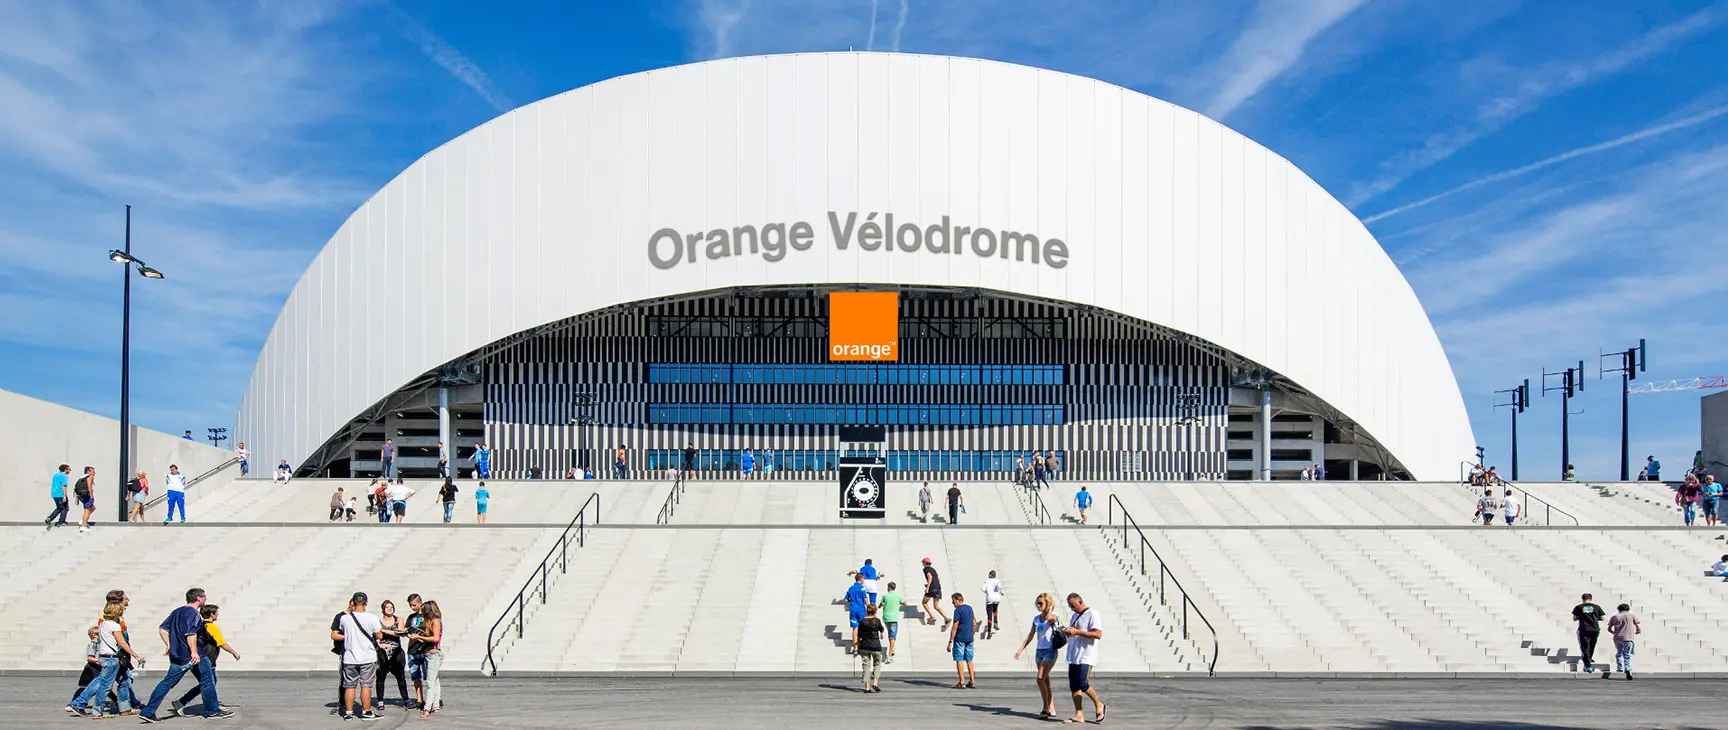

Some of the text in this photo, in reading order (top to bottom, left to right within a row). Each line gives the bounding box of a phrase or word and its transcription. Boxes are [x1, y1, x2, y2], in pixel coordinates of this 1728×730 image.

[648, 211, 1069, 270] Orange Vélodrome
[832, 344, 891, 360] orange
